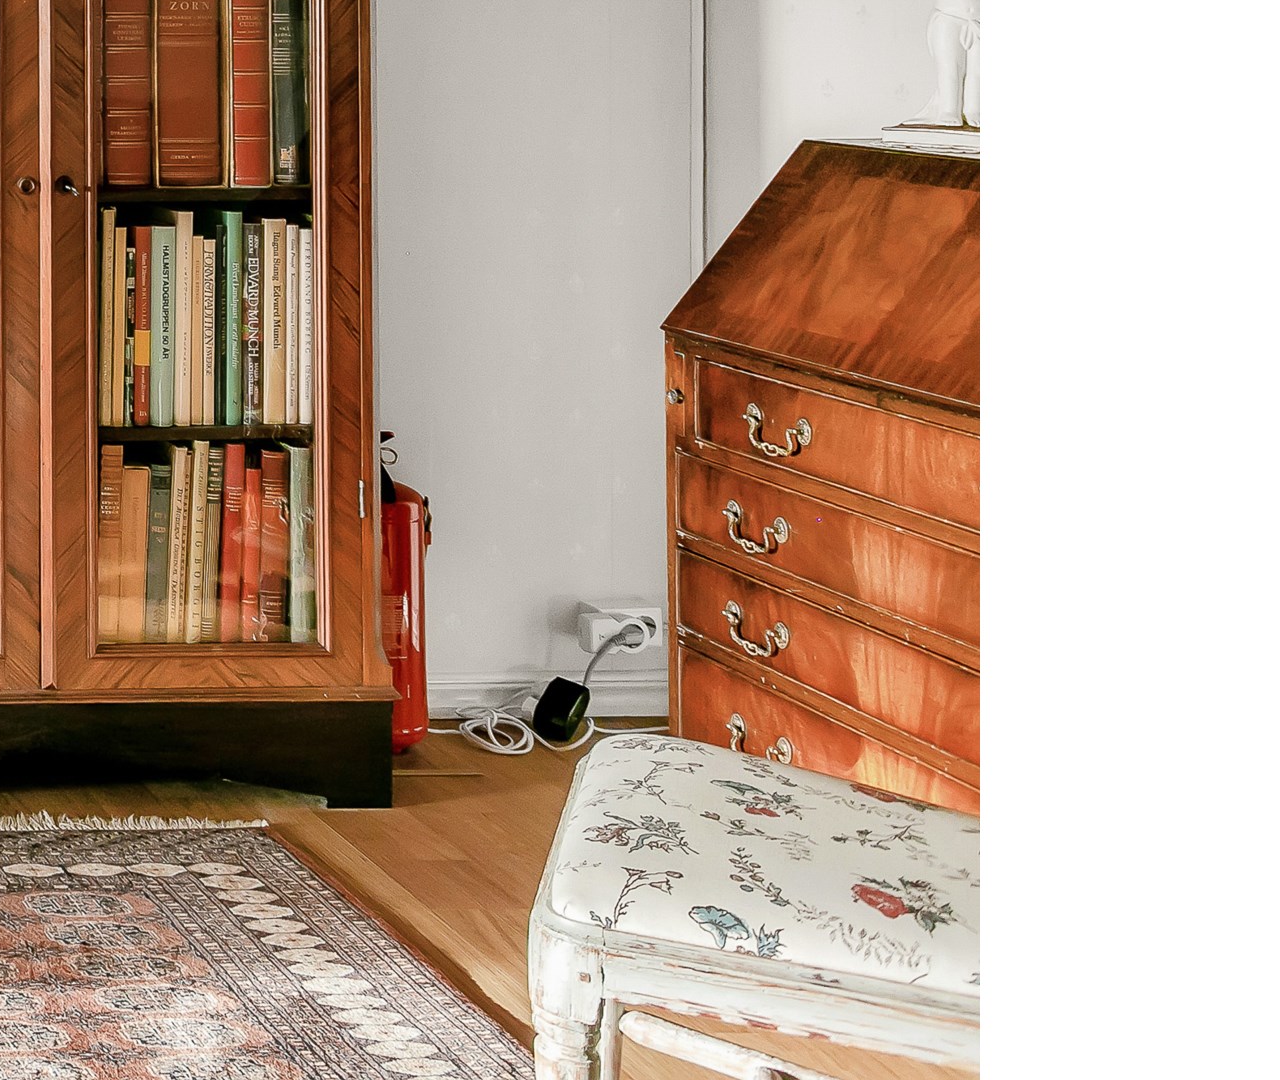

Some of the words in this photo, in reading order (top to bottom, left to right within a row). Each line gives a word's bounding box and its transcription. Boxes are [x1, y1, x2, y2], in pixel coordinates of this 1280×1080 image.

[169, 1, 209, 11] ZORN
[271, 231, 281, 257] Ragna
[247, 257, 259, 307] EDVARD
[271, 258, 281, 282] Stang
[162, 245, 170, 333] HALMSTADGRUPPEN
[230, 283, 239, 319] Lundquist
[273, 285, 281, 318] Edvard
[162, 335, 169, 345] 50
[247, 309, 259, 358] MUNCH
[273, 319, 281, 350] Munch
[162, 347, 171, 360] ÅR
[195, 505, 204, 549] STIG
